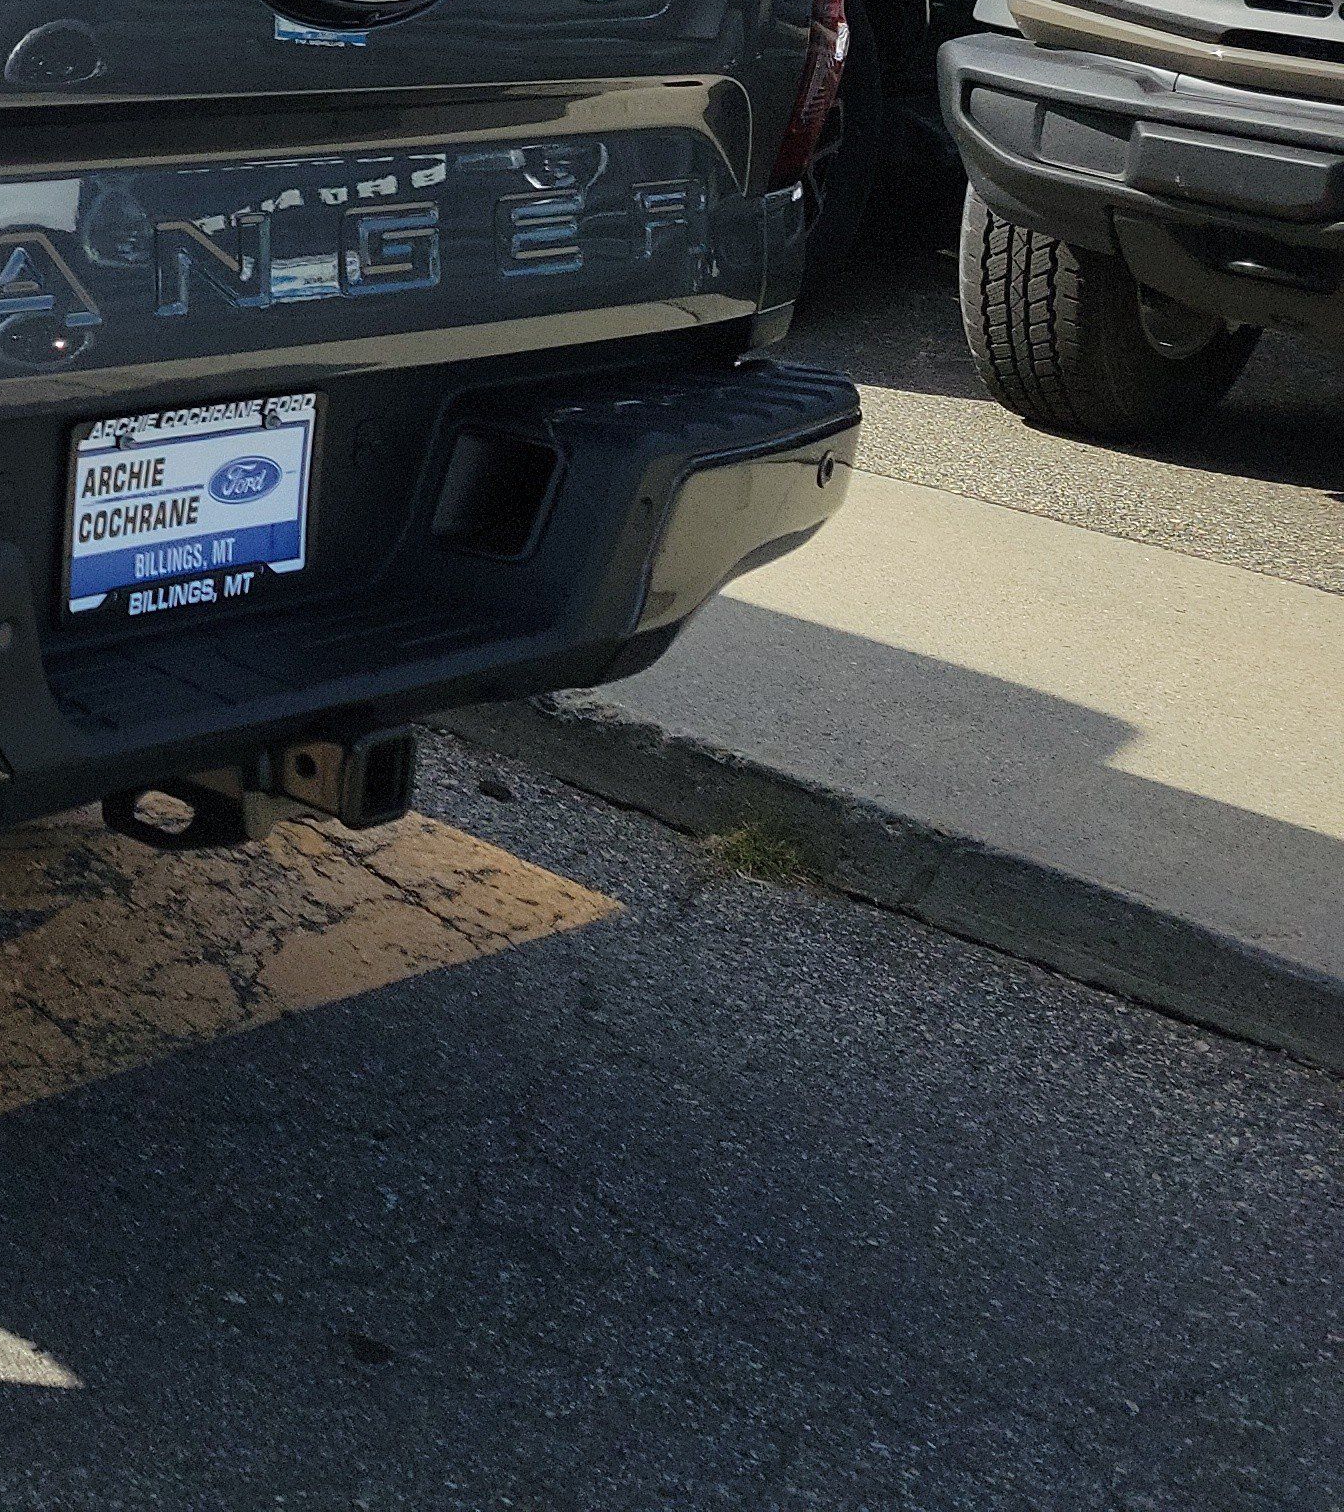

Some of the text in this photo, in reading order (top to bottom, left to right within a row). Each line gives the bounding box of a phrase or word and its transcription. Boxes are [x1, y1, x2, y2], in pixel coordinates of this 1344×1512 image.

[88, 393, 316, 440] ARCHIE COCHRANE FORD
[81, 457, 167, 499] ARCHIE
[223, 462, 266, 495] Ford
[78, 495, 201, 544] COCHRANE
[134, 537, 236, 579] BILLINGS, MT
[128, 571, 255, 616] BILLINGS, MT
